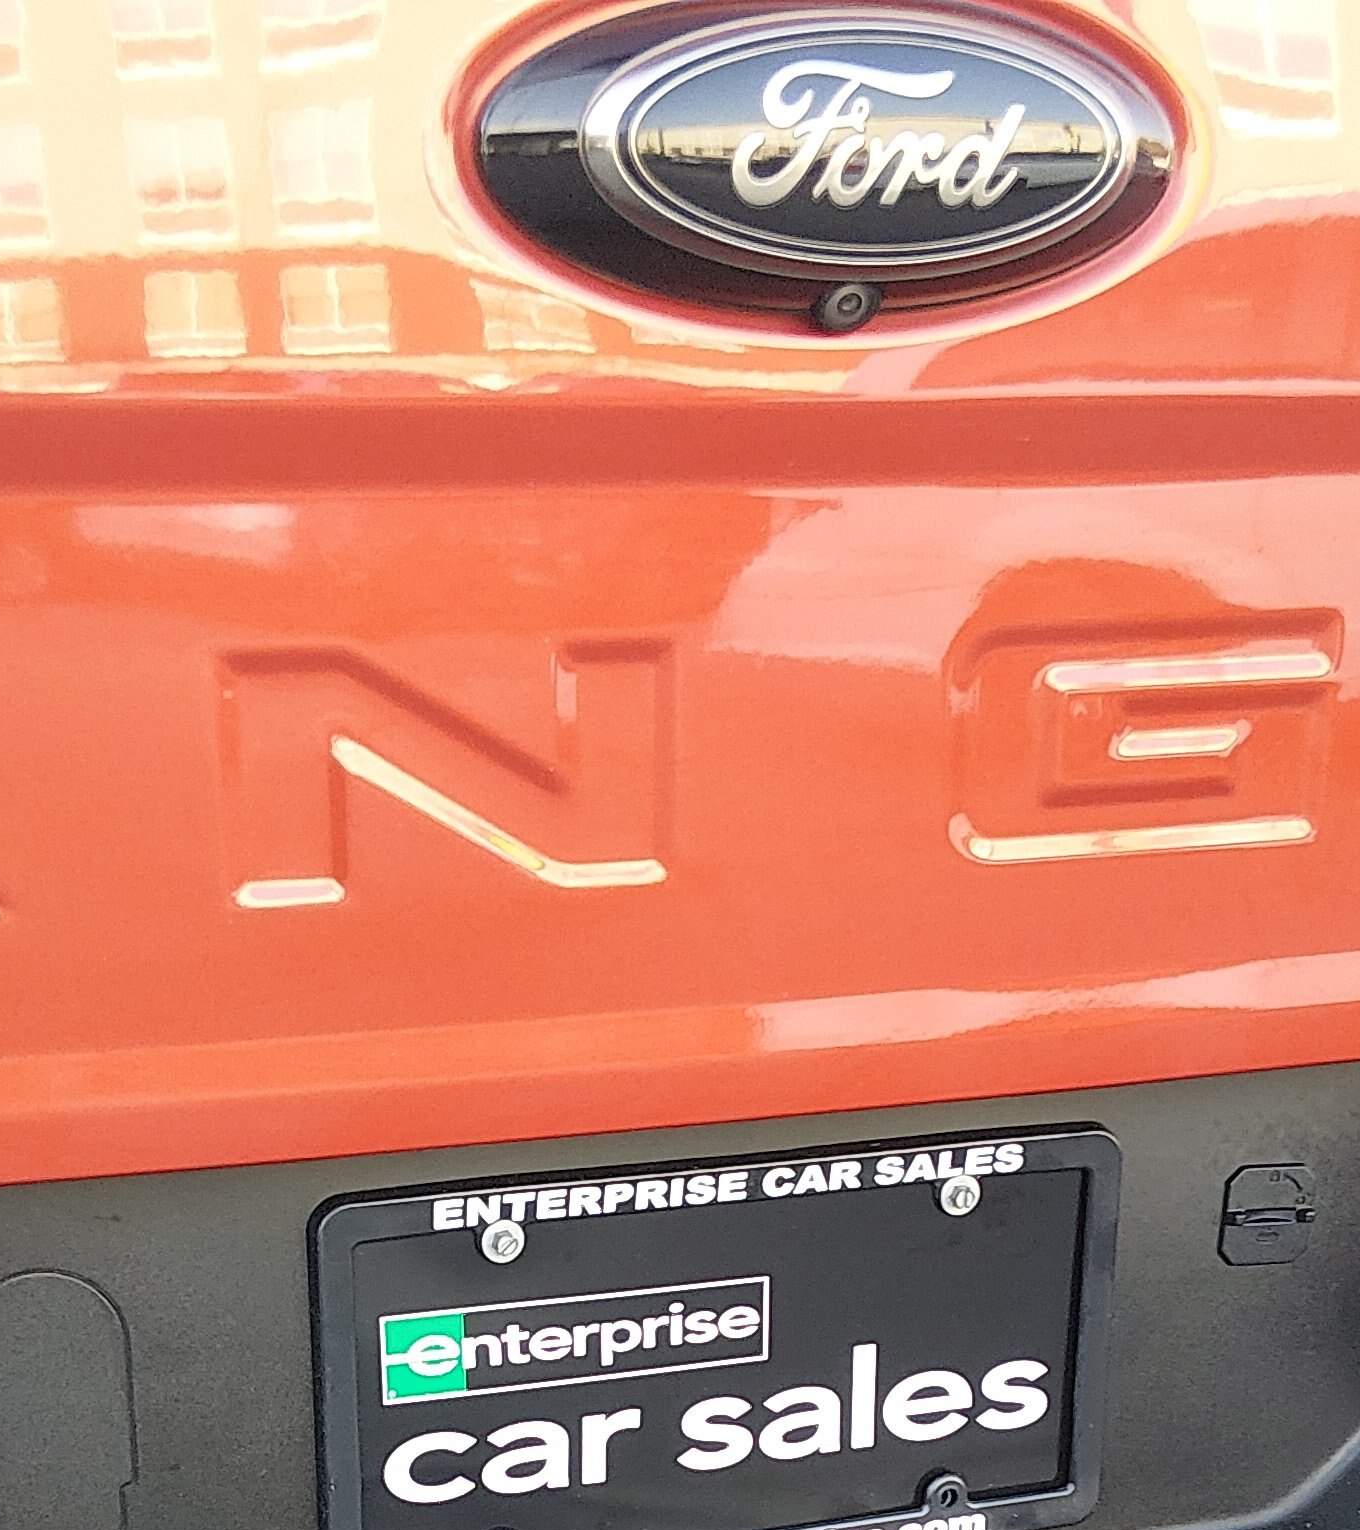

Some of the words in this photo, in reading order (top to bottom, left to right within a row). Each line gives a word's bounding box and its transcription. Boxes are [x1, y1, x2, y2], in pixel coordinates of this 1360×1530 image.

[732, 61, 1025, 208] Ford
[432, 1172, 748, 1231] ENTERPRISE
[760, 1158, 863, 1198] CAR
[874, 1144, 1026, 1187] SALES
[408, 1302, 760, 1378] enterprise
[383, 1407, 642, 1505] car
[677, 1344, 1050, 1472] sales
